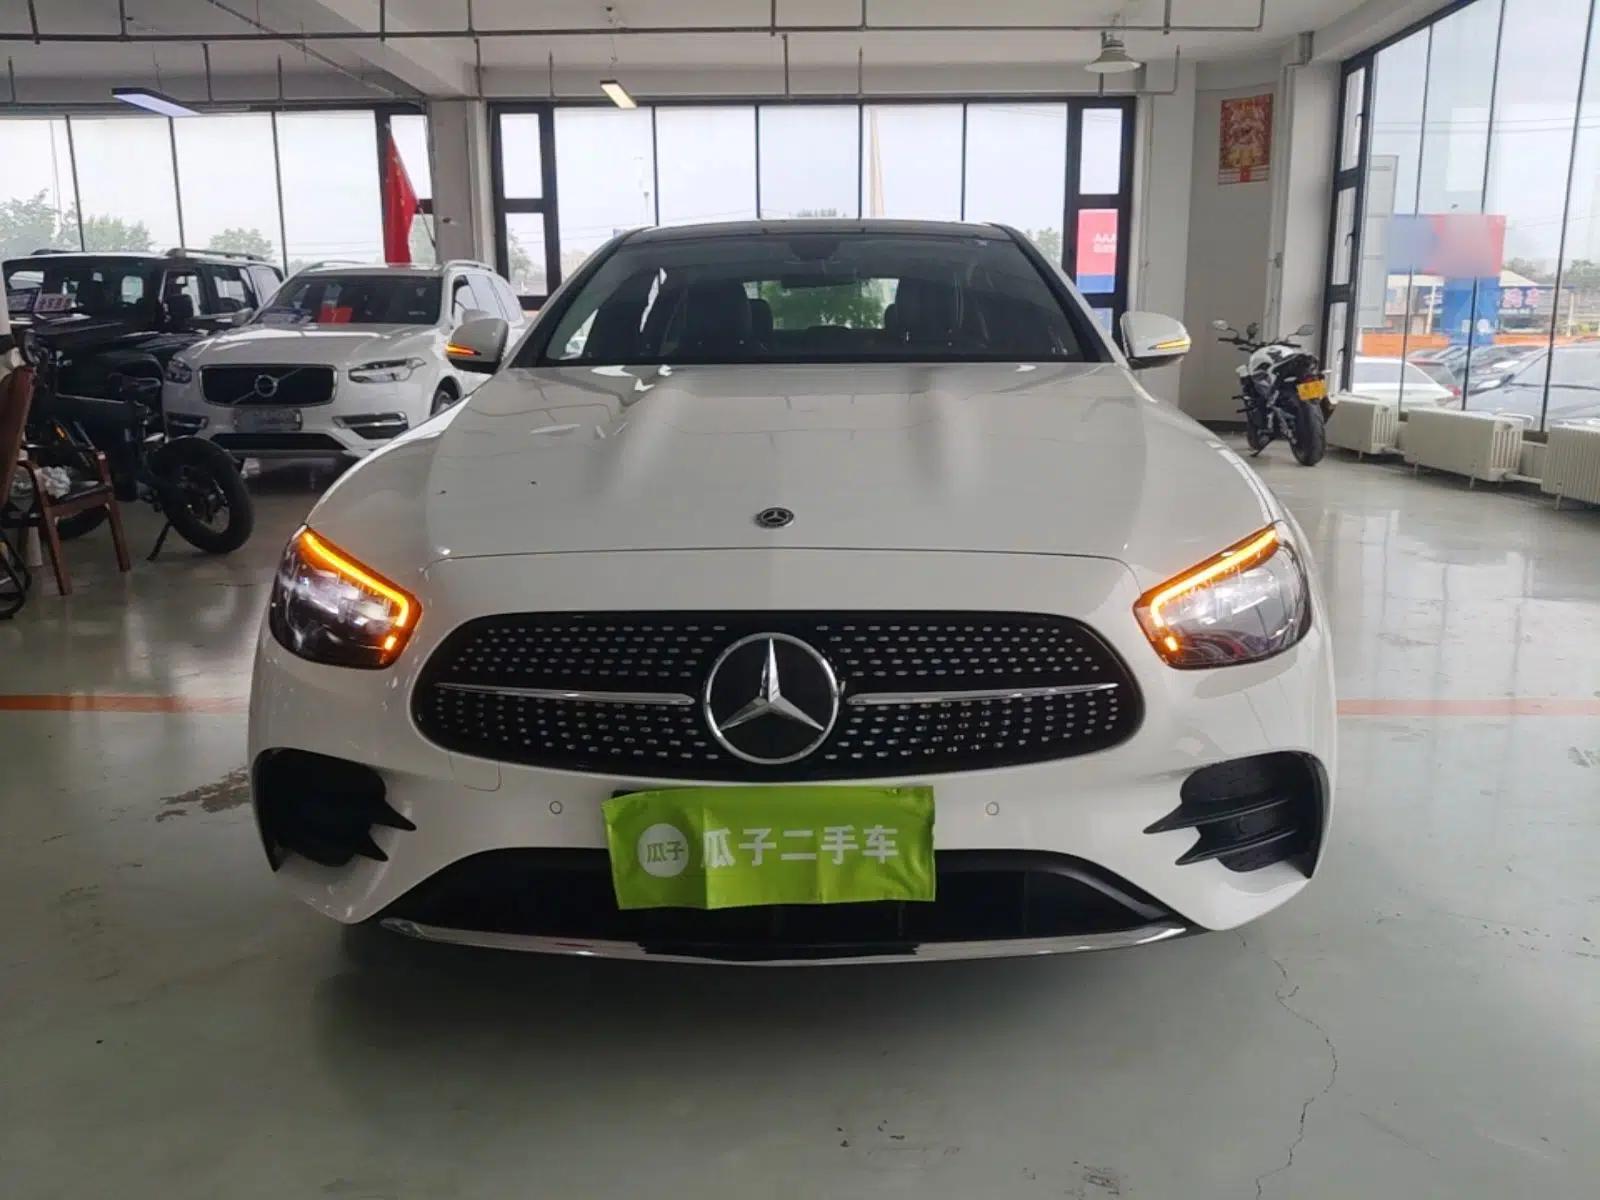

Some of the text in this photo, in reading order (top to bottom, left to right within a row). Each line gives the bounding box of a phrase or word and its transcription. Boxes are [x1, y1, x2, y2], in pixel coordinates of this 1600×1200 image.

[647, 841, 684, 863] 瓜子
[702, 824, 899, 868] 瓜子二手车
